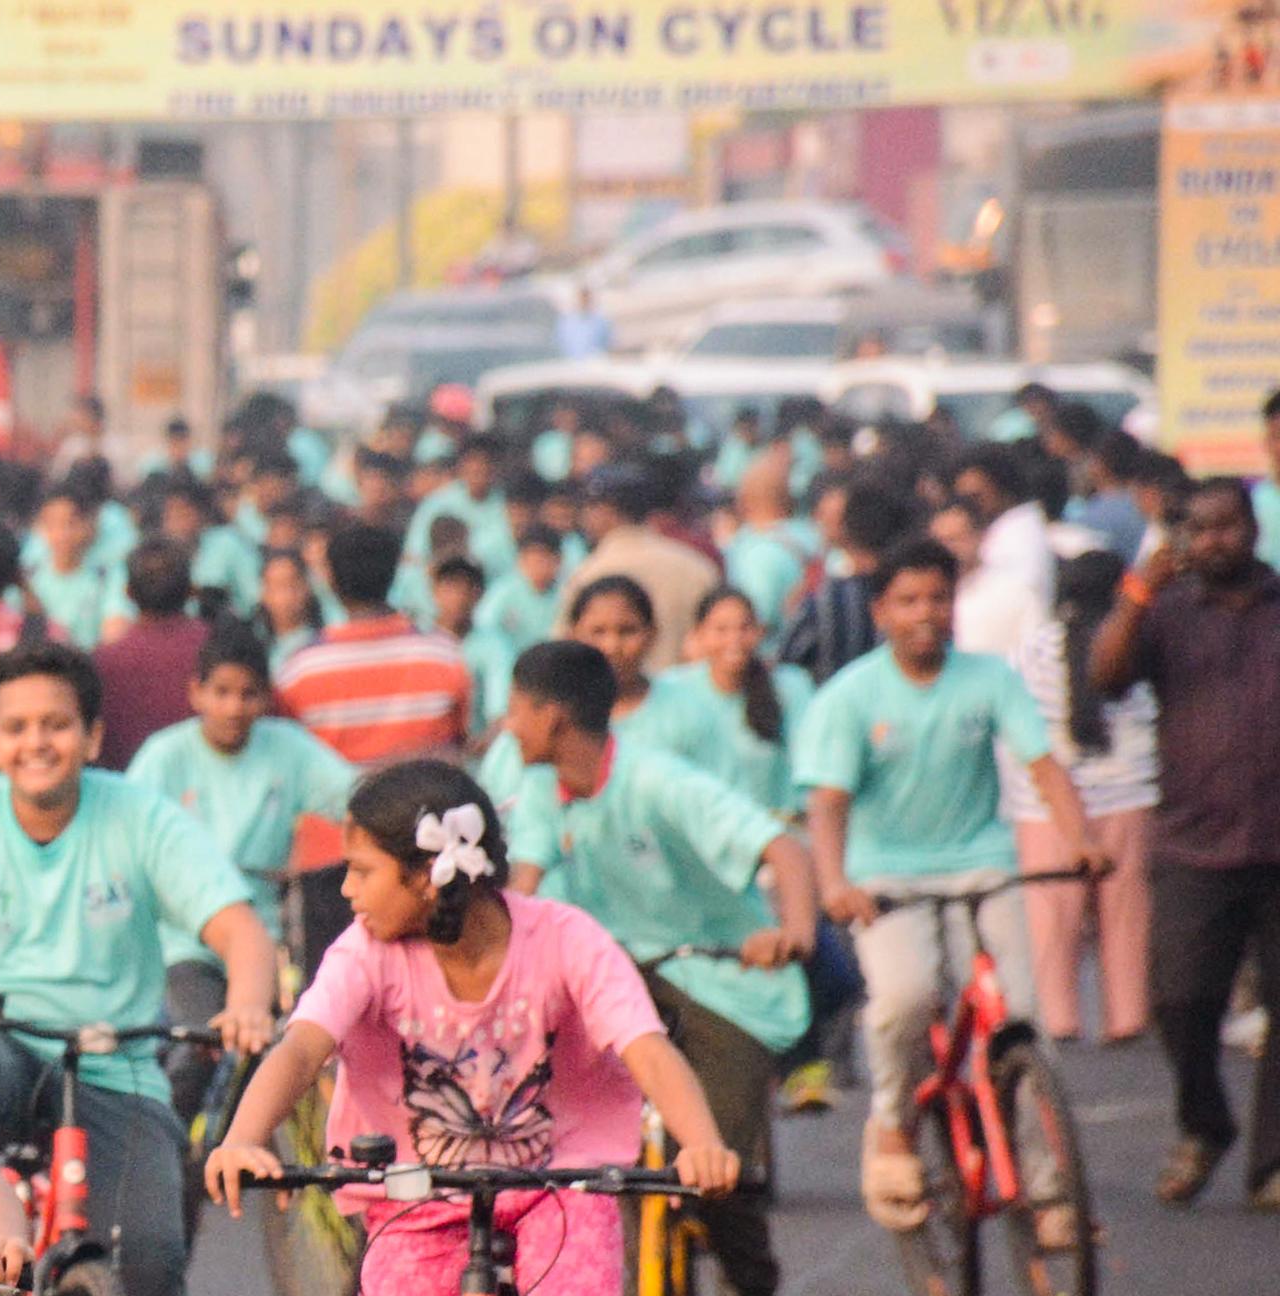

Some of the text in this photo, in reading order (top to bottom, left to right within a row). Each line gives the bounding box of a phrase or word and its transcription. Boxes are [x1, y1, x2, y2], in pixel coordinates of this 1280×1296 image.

[175, 14, 504, 65] SUNDAYS
[534, 12, 630, 59] ON
[661, 5, 885, 57] CYCLE
